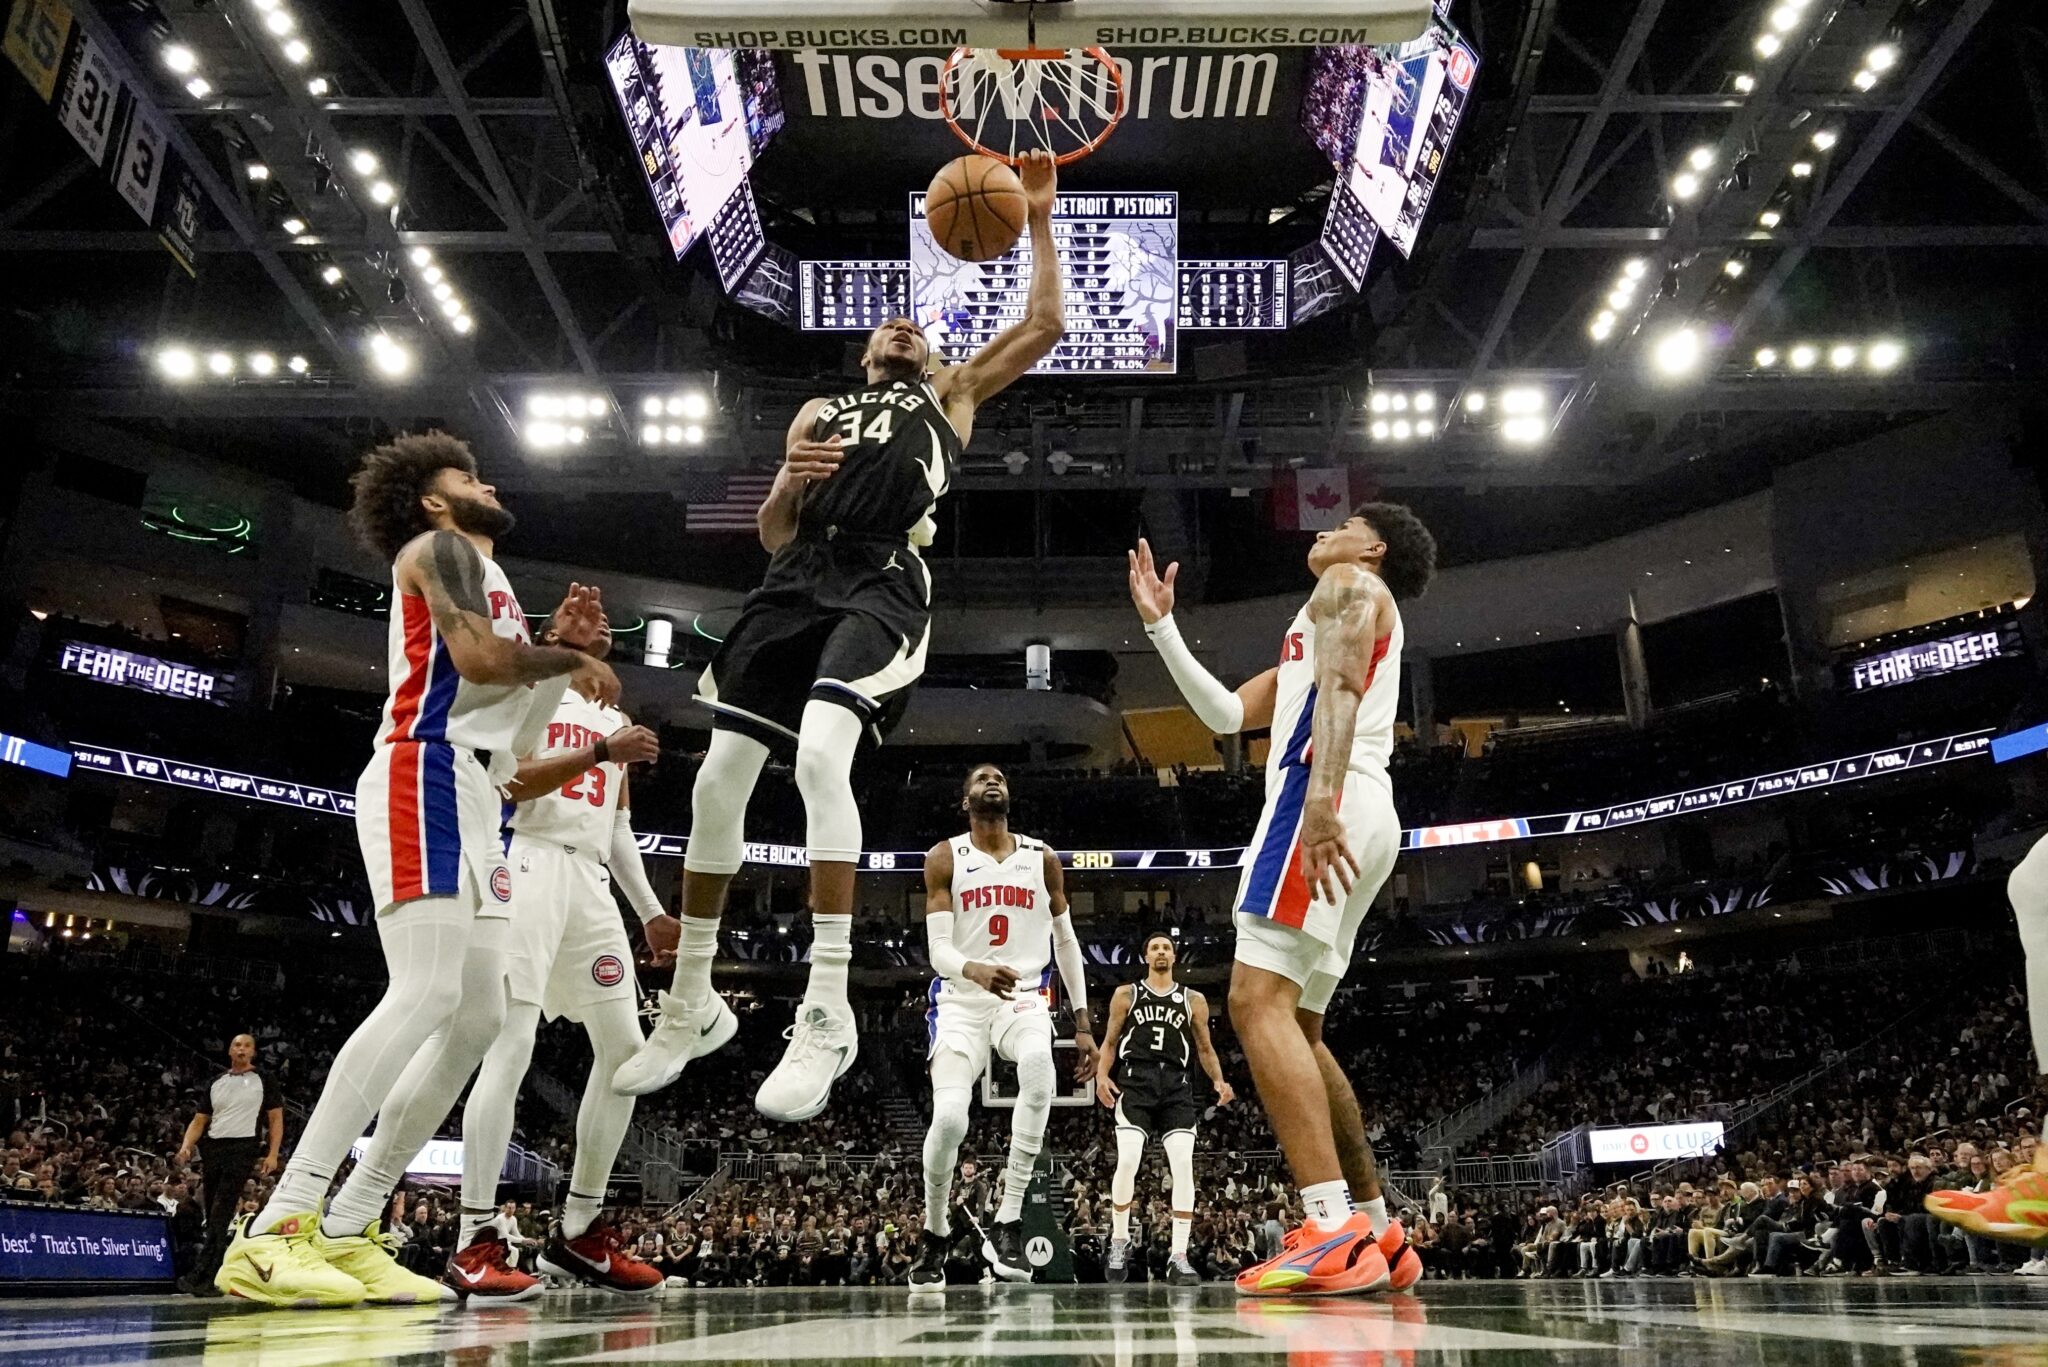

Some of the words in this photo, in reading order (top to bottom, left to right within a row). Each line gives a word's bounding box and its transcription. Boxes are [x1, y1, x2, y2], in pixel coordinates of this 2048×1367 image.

[694, 28, 968, 48] SHOP.BUCKS.COM
[1096, 27, 1367, 44] SHOP.BUCKS.COM
[1066, 46, 1279, 121] forum
[77, 69, 111, 137] 31
[634, 95, 650, 126] 86
[664, 181, 679, 209] 75
[1407, 180, 1422, 207] 86
[1434, 93, 1450, 123] 75
[132, 138, 154, 189] 3
[644, 150, 657, 175] 3RD
[1052, 197, 1109, 215] DETROIT
[1113, 197, 1173, 215] PISTONS
[1088, 238, 1095, 248] 1
[825, 274, 832, 283] 3
[846, 274, 853, 283] 3
[864, 274, 869, 283] 1
[881, 274, 887, 283] 2
[899, 274, 903, 283] 1
[846, 285, 853, 294] 0
[882, 285, 887, 294] 1
[898, 285, 905, 294] 2
[1182, 285, 1189, 294] 7
[1202, 285, 1209, 294] 0
[1220, 285, 1226, 294] 3
[1237, 285, 1244, 294] 3
[1254, 285, 1260, 294] 2
[1202, 274, 1210, 283] 11
[1237, 274, 1244, 283] 0
[1254, 274, 1260, 283] 2
[824, 296, 834, 305] 13
[846, 296, 853, 305] 0
[864, 296, 870, 305] 2
[883, 296, 887, 305] 1
[898, 296, 905, 305] 0
[1098, 292, 1111, 302] 10
[1202, 296, 1209, 305] 0
[1219, 296, 1226, 305] 2
[1238, 296, 1243, 305] 1
[1255, 296, 1259, 305] 1
[823, 306, 836, 315] 25
[846, 306, 853, 315] 0
[863, 306, 870, 315] 0
[881, 306, 888, 315] 0
[900, 306, 904, 315] 1
[823, 318, 836, 326] 34
[844, 318, 856, 326] 24
[1179, 318, 1192, 326] 23
[1200, 318, 1211, 326] 12
[1238, 318, 1243, 326] 1
[1253, 318, 1260, 326] 2
[1180, 307, 1191, 315] 12
[1202, 307, 1209, 315] 3
[1221, 307, 1225, 315] 1
[1236, 307, 1244, 315] 0
[1255, 307, 1259, 315] 1
[818, 391, 925, 423] BUCKS
[837, 409, 894, 447] 34
[1853, 652, 1913, 689] FEAR
[1911, 650, 1939, 669] THE
[1938, 632, 2001, 669] DEER
[62, 645, 128, 681] FEAR
[127, 662, 154, 681] THE
[153, 664, 214, 700] DEER
[92, 755, 111, 765] PM
[136, 760, 159, 775] FG
[219, 776, 251, 791] 3PT
[307, 792, 327, 805] FT
[561, 766, 607, 807] 23
[869, 854, 895, 869] 86
[1072, 853, 1113, 868] 3RD
[1185, 852, 1211, 867] 75
[1727, 785, 1745, 799] FT
[1801, 769, 1829, 784] FLS
[1874, 753, 1906, 768] TOL
[960, 885, 1035, 912] PISTONS
[989, 914, 1009, 947] 9
[1133, 1005, 1186, 1030] BUCKS
[1150, 1026, 1165, 1050] 3
[1663, 1131, 1714, 1150] CLUB
[42, 1234, 77, 1254] That's
[76, 1236, 100, 1255] The
[101, 1236, 130, 1256] Silver
